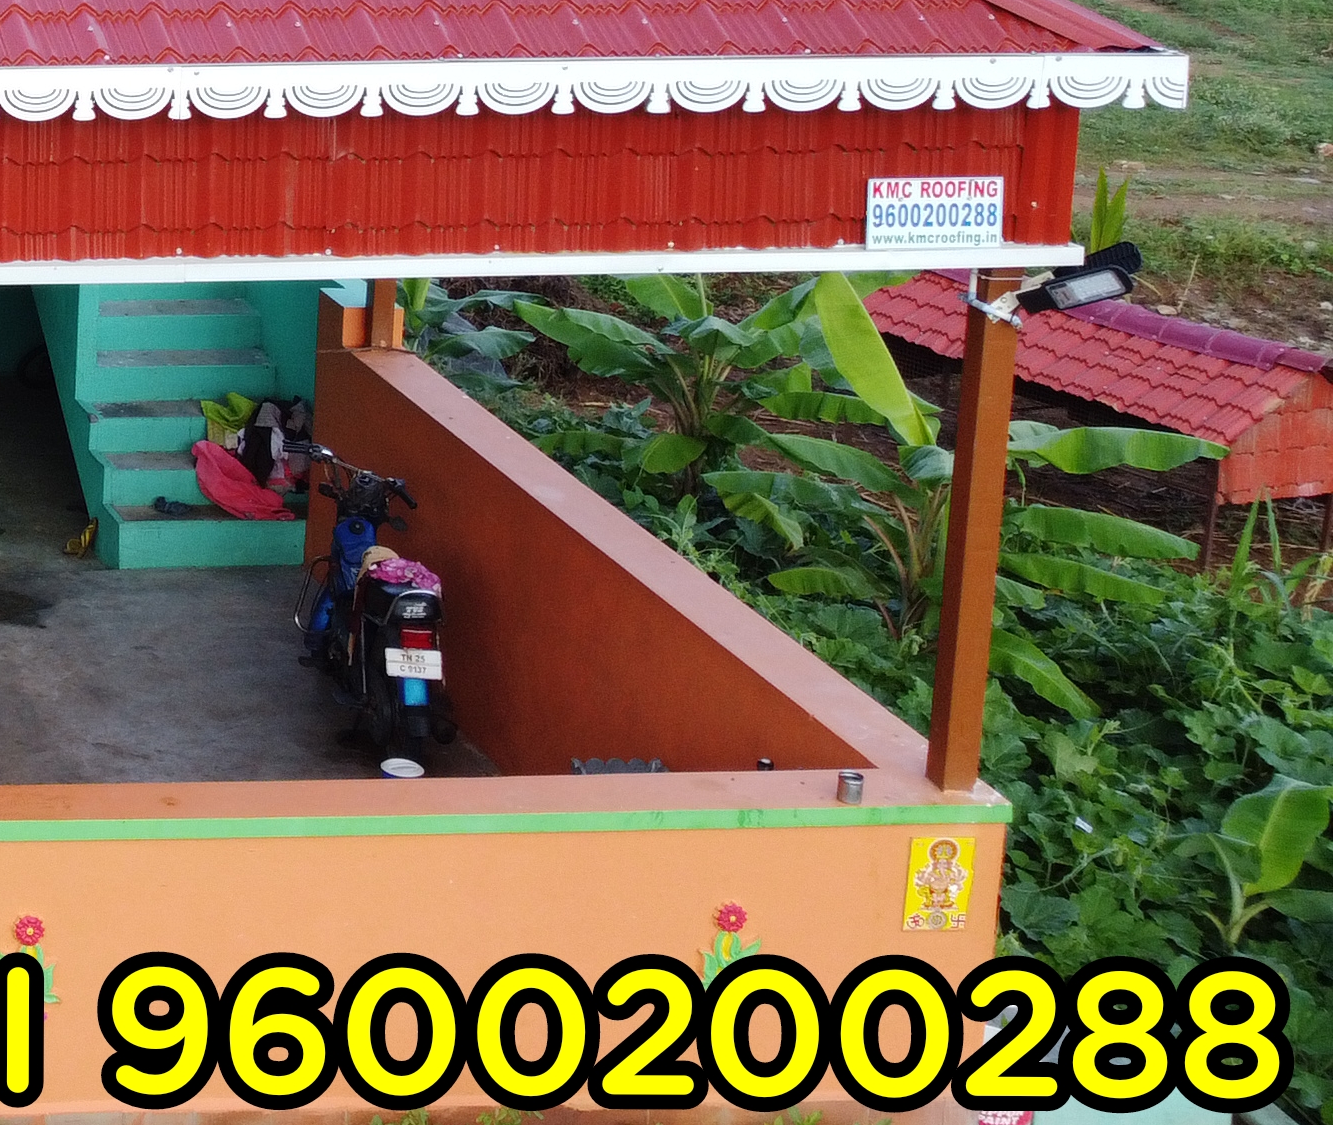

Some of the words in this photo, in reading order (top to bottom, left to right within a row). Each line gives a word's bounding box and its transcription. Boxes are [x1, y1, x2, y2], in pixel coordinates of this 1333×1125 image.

[872, 180, 913, 199] KMC
[919, 179, 998, 198] ROOFING
[872, 202, 998, 228] 9600200288
[872, 231, 998, 246] www.kmcroofing.in
